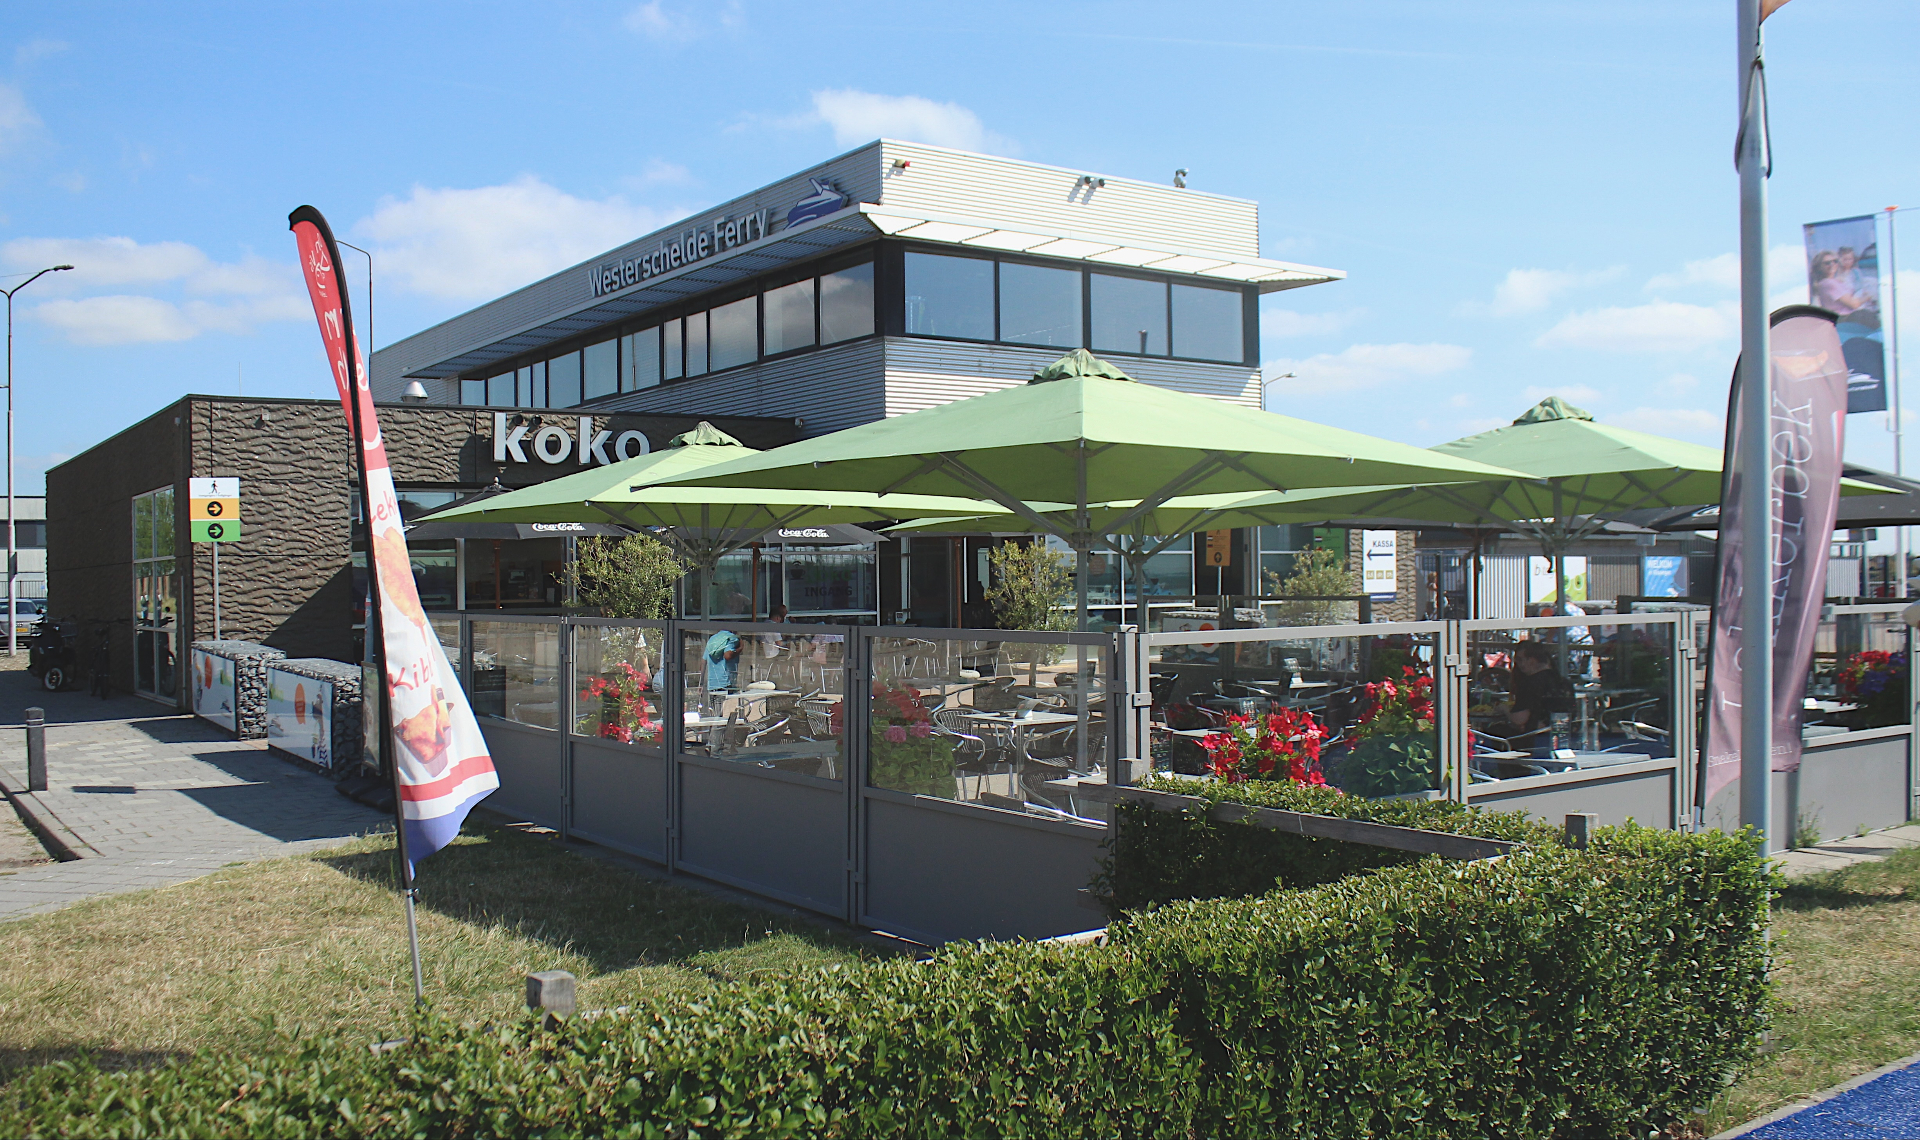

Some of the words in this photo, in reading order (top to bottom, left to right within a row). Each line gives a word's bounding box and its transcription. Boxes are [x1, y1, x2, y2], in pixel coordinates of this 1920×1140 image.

[588, 227, 709, 298] Westerschelde
[714, 208, 768, 252] Ferry
[493, 411, 651, 465] koko
[531, 522, 587, 532] Coca-Cola
[778, 528, 830, 538] Coca-Cola
[1372, 540, 1394, 548] KASSA
[804, 586, 853, 598] INGANG
